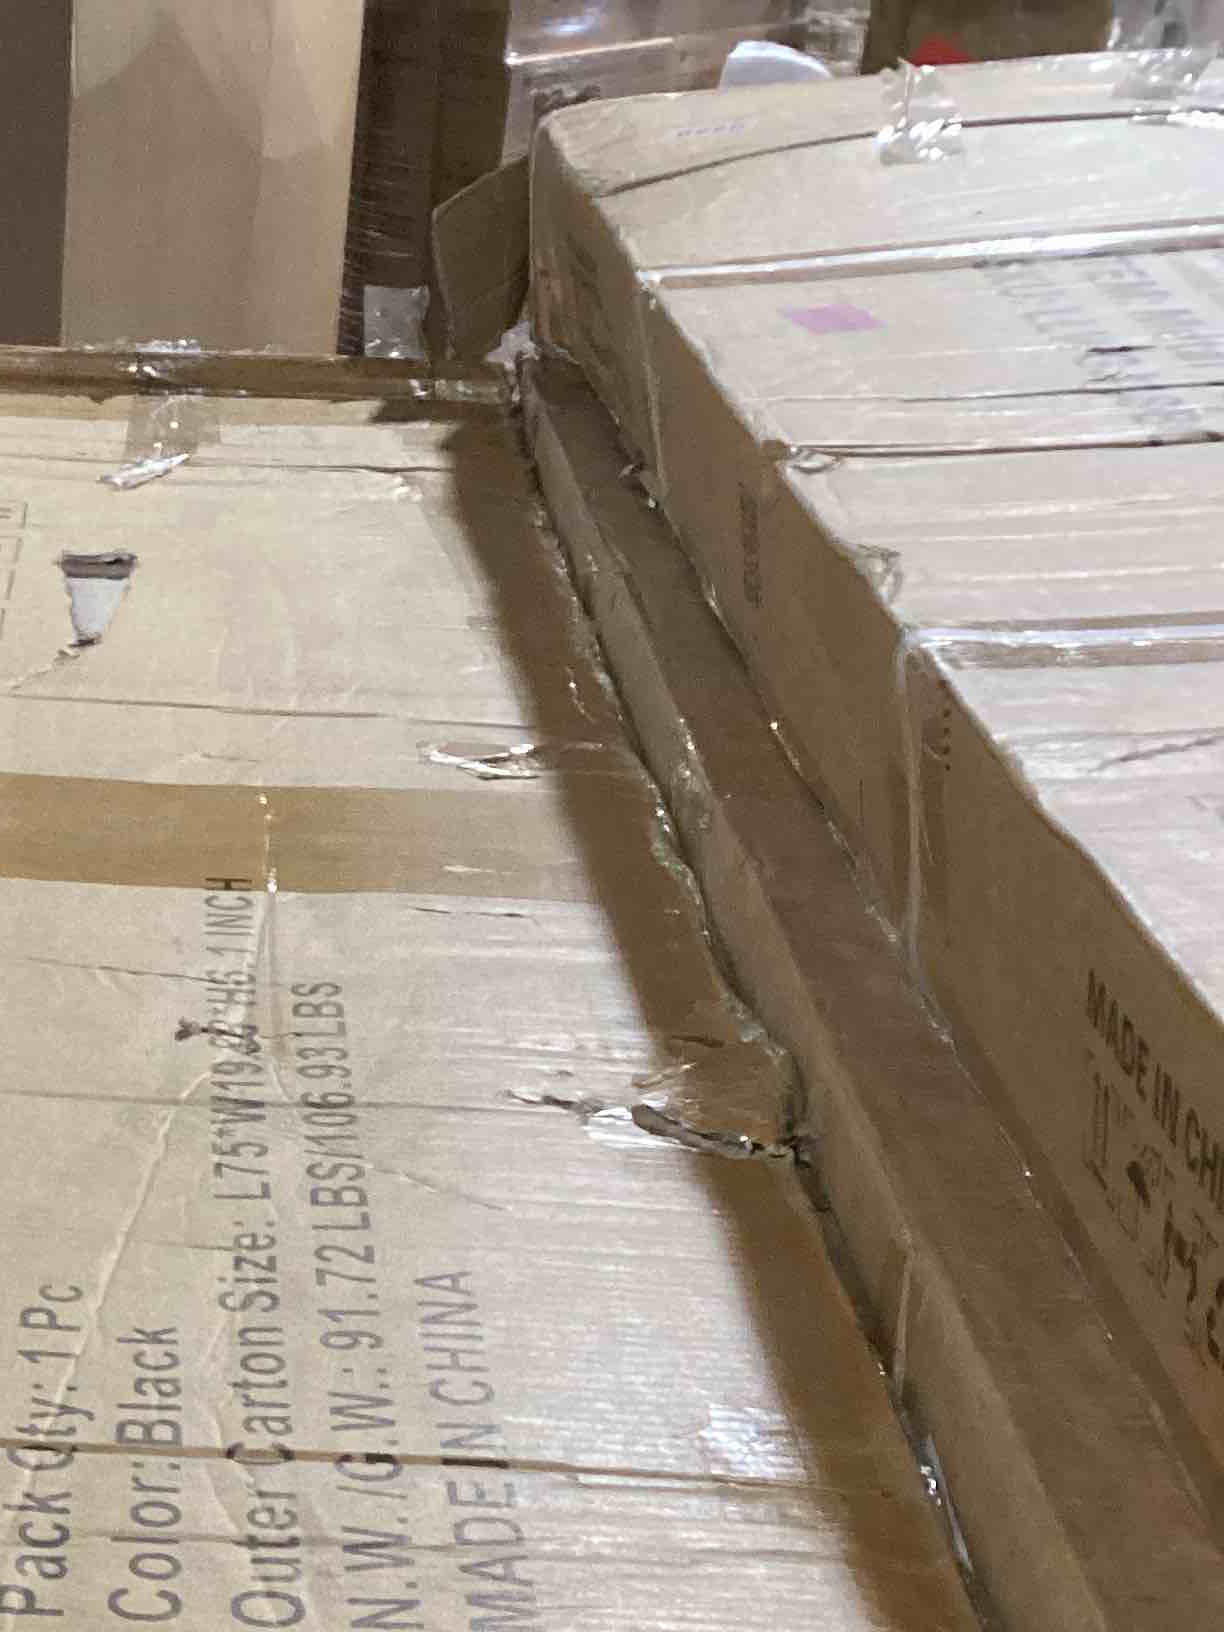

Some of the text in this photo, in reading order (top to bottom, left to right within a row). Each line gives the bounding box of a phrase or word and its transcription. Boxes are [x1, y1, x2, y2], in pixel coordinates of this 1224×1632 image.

[16, 1349, 80, 1364] 1
[19, 1283, 84, 1332] Pc
[313, 1244, 385, 1350] 91.72
[414, 1269, 496, 1407] CHINA
[107, 1326, 183, 1622] Color: Black
[218, 1220, 306, 1629] Outer Carton Size:
[445, 1480, 550, 1632] MADE
